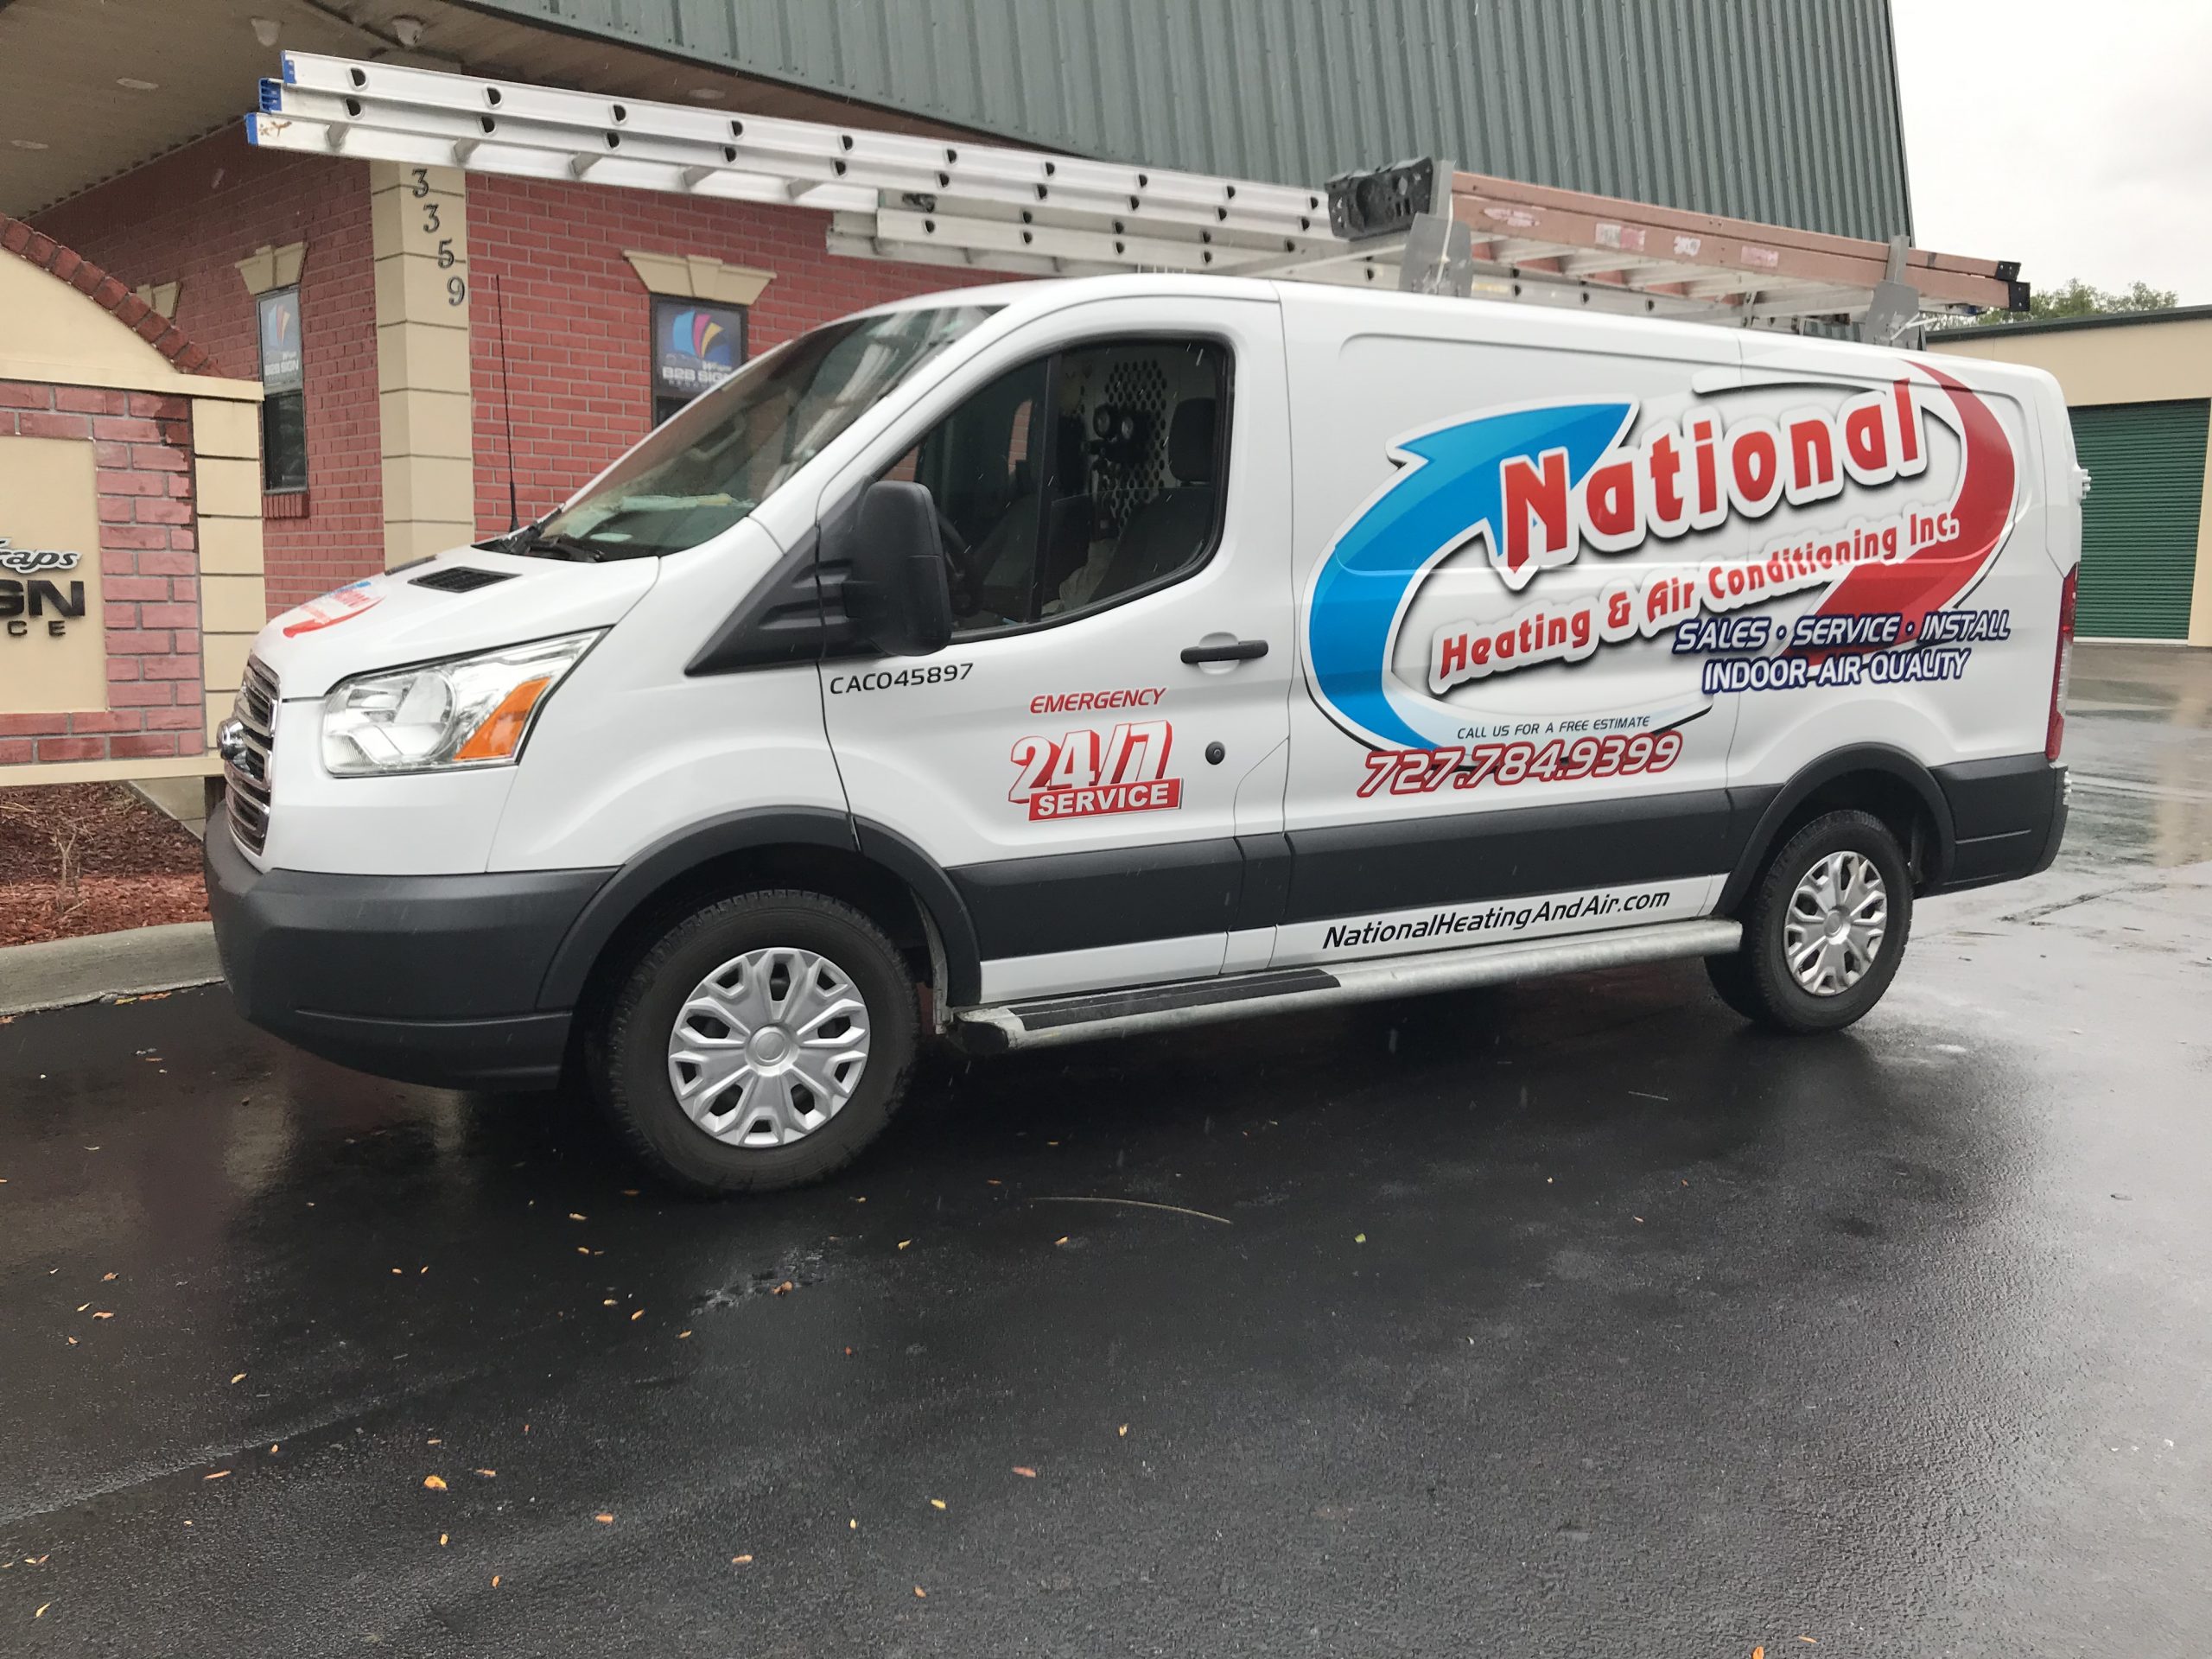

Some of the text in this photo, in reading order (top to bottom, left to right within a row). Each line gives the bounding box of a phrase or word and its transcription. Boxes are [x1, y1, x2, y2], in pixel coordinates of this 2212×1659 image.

[662, 365, 696, 383] B2B
[1504, 378, 1918, 574] National
[0, 537, 82, 574] raps
[1440, 512, 1956, 680] Heating & Air Conditioning Inc.
[1673, 609, 2012, 654] SALES SERVICE INSTALL
[1703, 648, 1971, 694] INDOOR AIR QUALITY
[1029, 687, 1167, 714] EMERGENCY
[1457, 716, 1650, 740] CALL US FOR A FREE ESTIMATE
[1008, 720, 1173, 804] 24/7
[1357, 730, 1683, 798] 727.784.9399
[1037, 783, 1169, 816] SERVICE
[1322, 891, 1670, 950] NationalHeatingAndAir.com
